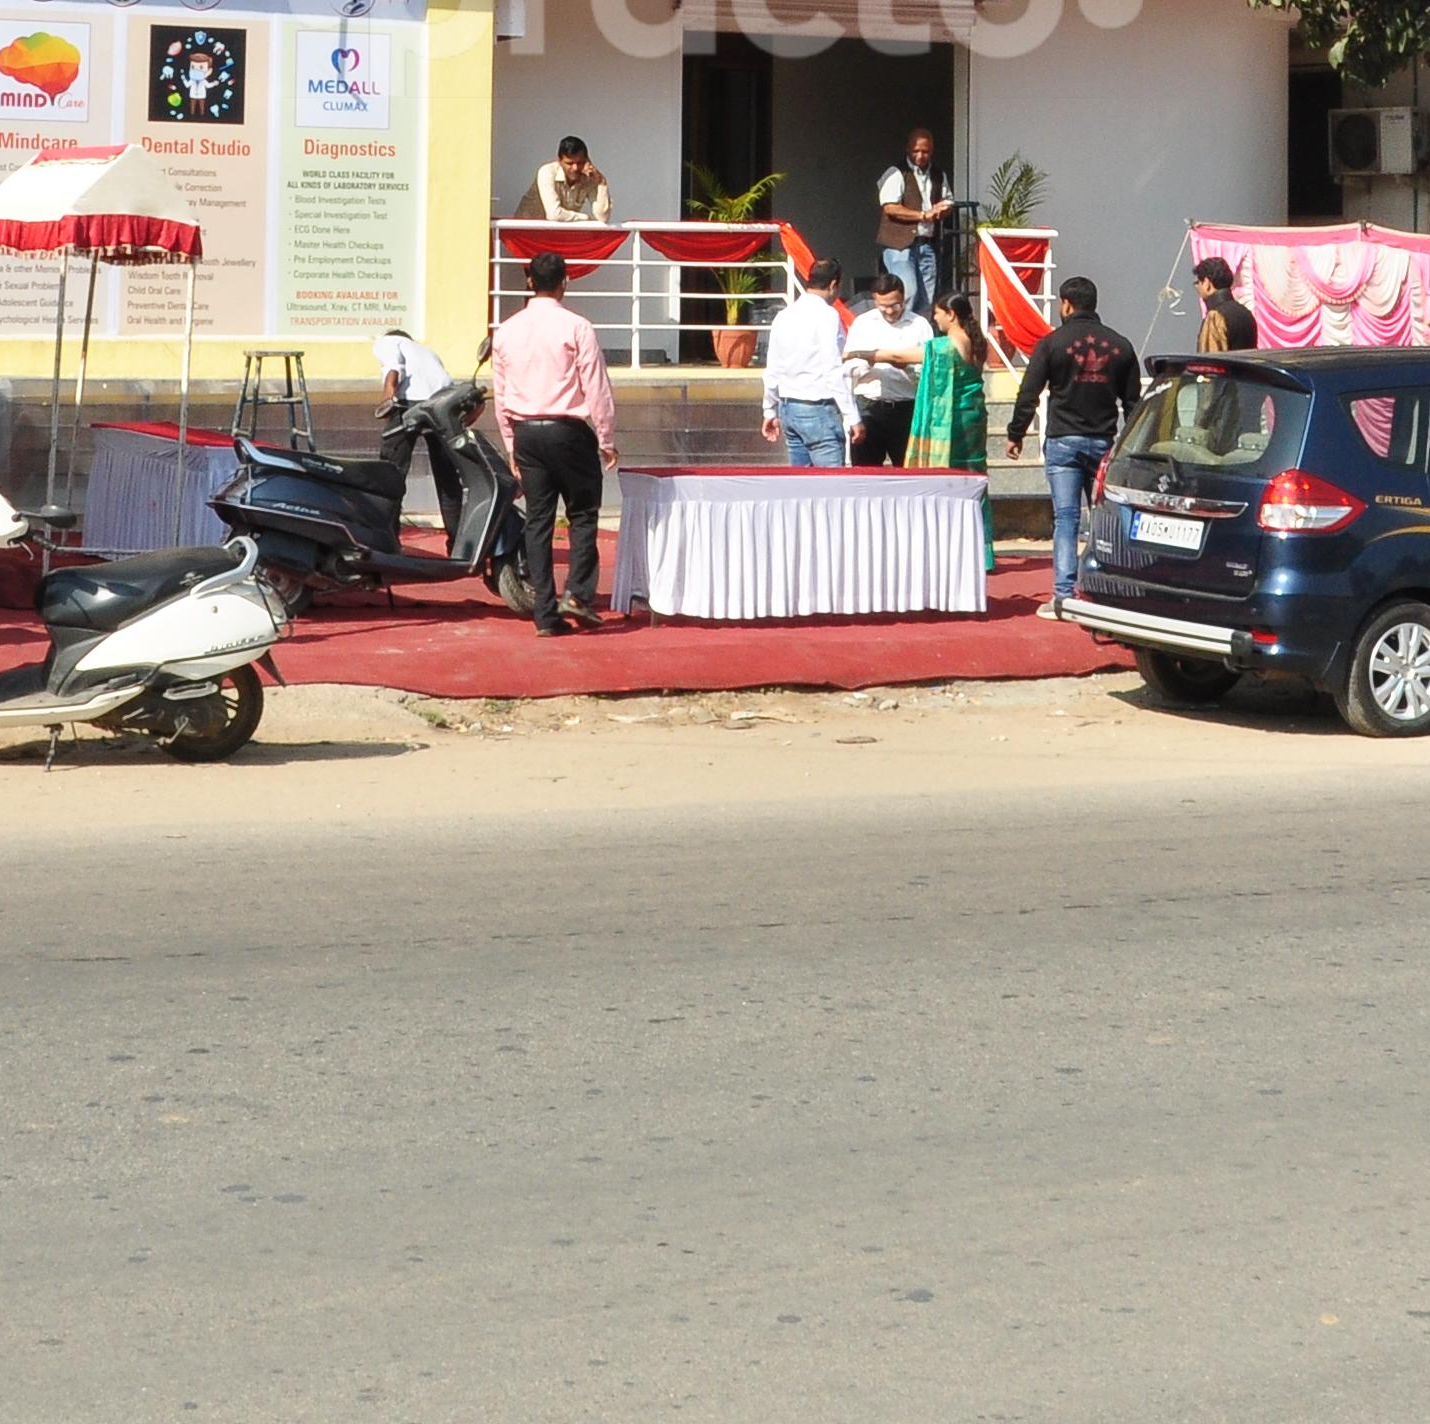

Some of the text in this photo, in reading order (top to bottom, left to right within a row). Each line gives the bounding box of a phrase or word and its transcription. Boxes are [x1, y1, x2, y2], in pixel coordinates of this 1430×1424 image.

[308, 80, 380, 95] MEDALL
[0, 92, 85, 108] MIND Care
[323, 102, 368, 112] CLUMAX
[142, 137, 251, 157] Dental Studio
[305, 139, 395, 159] Diagnostics
[168, 168, 216, 177] Consultations
[303, 170, 326, 178] WORLD
[352, 171, 380, 179] FACILITY
[185, 183, 222, 192] Correction
[287, 181, 298, 189] ALL
[333, 182, 376, 190] LABORATORY
[379, 183, 409, 191] SERVICES
[199, 199, 246, 208] Management
[295, 196, 386, 206] Blood Investigation Tests
[295, 211, 387, 221] Special Investigation Test
[294, 226, 309, 234] ECG
[312, 226, 330, 234] Done
[294, 241, 384, 251] Master Health Checkups
[222, 258, 256, 268] Jewellery
[308, 256, 354, 265] Employment
[356, 256, 391, 265] Checkups
[14, 265, 32, 273] other
[129, 271, 180, 280] Wisdom Tooth
[294, 270, 393, 280] Corporate Health Checkups
[5, 281, 29, 290] Sexual
[128, 287, 181, 295] Child Oral Care
[296, 291, 333, 299] BOOKING
[336, 291, 379, 299] AVAILABLE
[128, 302, 165, 310] Preventive
[352, 304, 361, 312] CT
[384, 304, 407, 312] Mamo
[144, 317, 166, 325] Health
[169, 317, 182, 325] and
[290, 317, 402, 326] TRANSPORTATION AVAILABLE
[1375, 496, 1423, 506] ERTIGA
